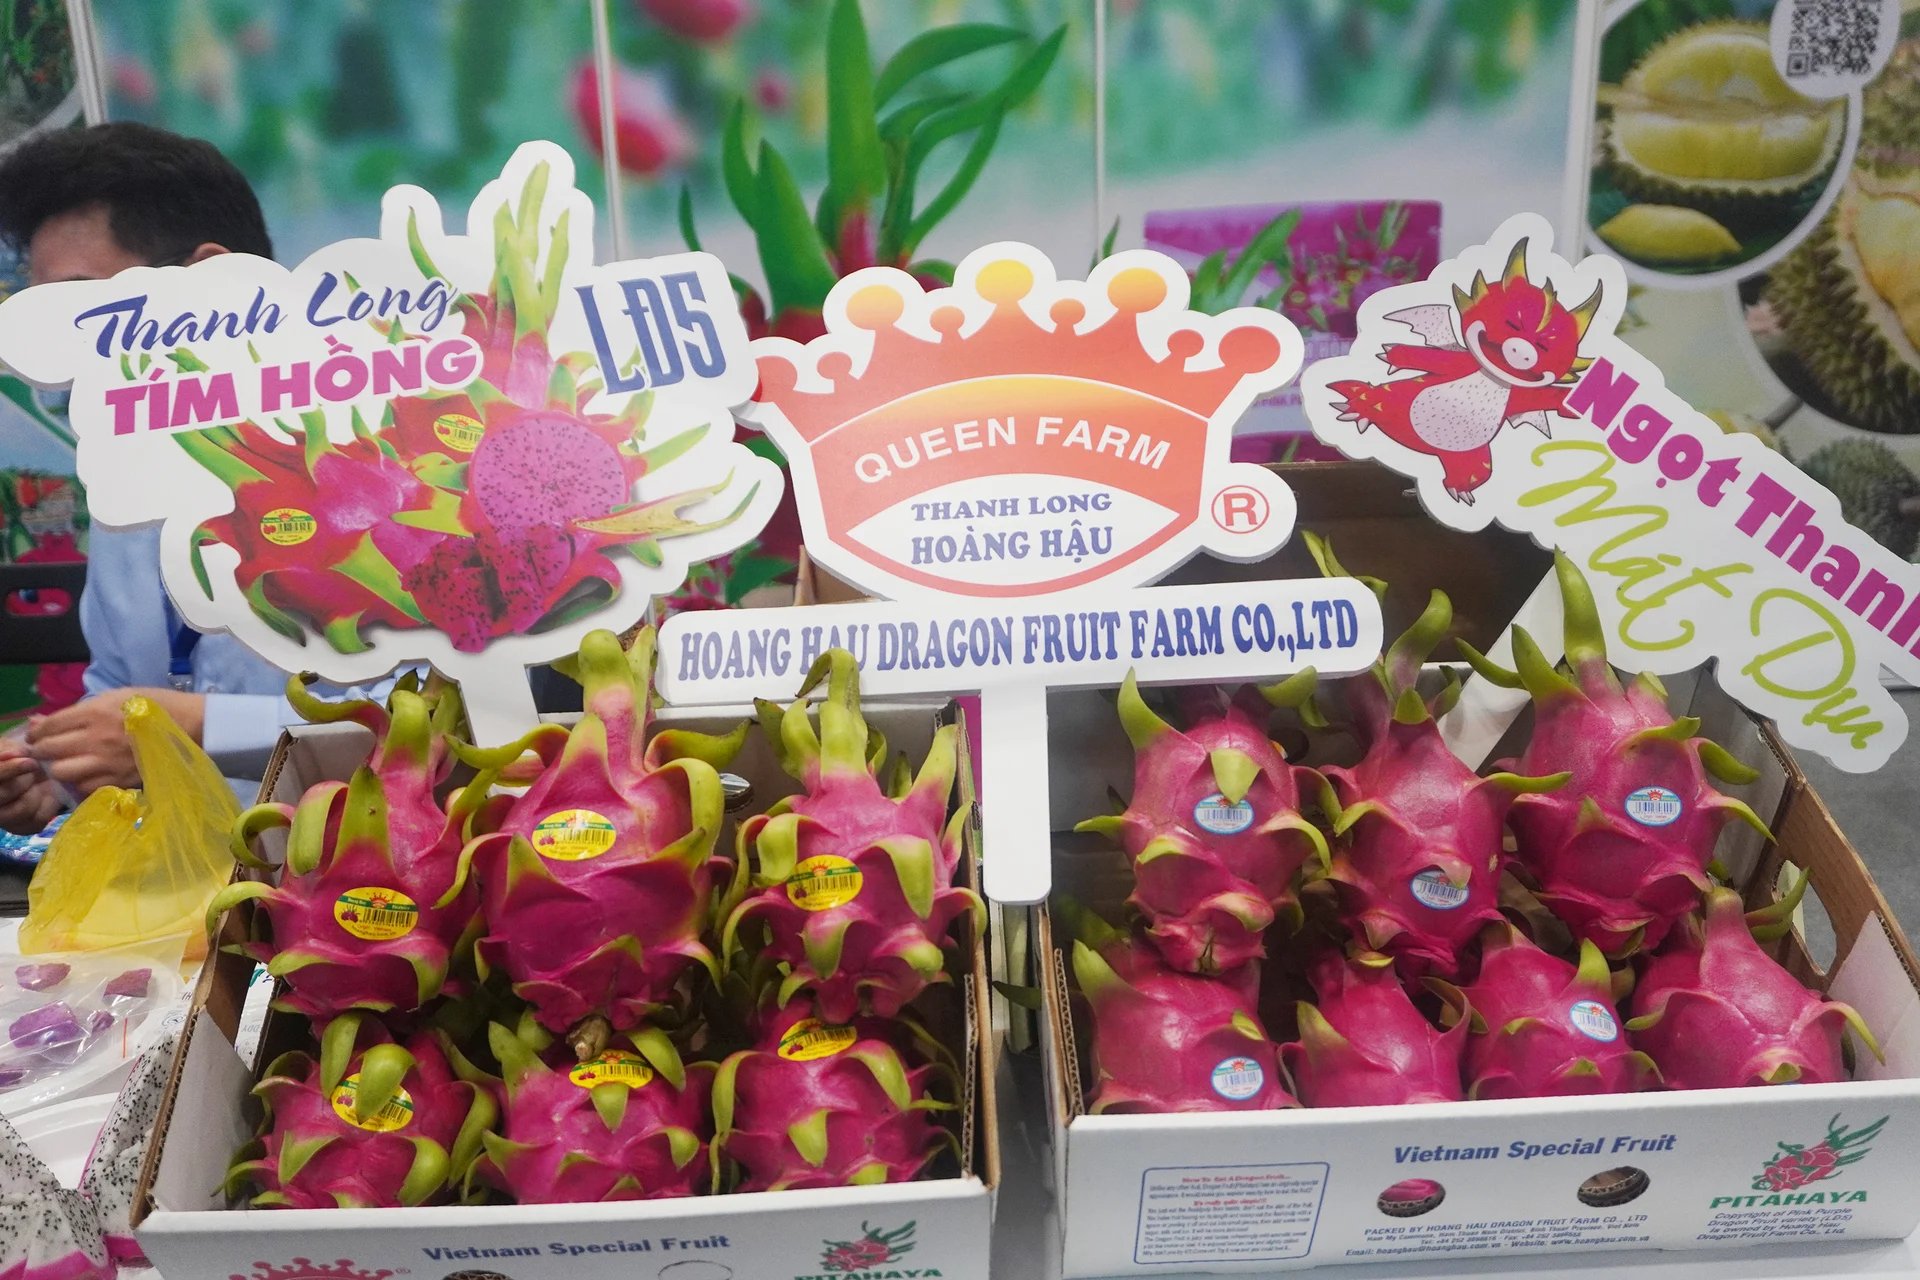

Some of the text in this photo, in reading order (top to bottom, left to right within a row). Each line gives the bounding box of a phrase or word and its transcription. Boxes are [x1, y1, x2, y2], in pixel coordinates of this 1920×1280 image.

[74, 271, 458, 358] Thanh Long
[573, 271, 727, 395] LĐ5
[105, 334, 477, 436] TÍM HỒNG
[1565, 355, 1742, 508] Ngọt
[854, 415, 1171, 483] QUEEN FARM
[911, 493, 1113, 521] THANH LONG
[911, 519, 1113, 565] HOÀNG HẬU
[678, 628, 791, 681] HOANG
[876, 616, 1014, 672] DRAGON
[1022, 611, 1121, 664] FRUIT
[1129, 605, 1225, 659] FARM
[1395, 1134, 1677, 1163] Vietnam Special Fruit
[1709, 1190, 1867, 1208] PITAHAYA
[1364, 1227, 1405, 1236] PACKED
[1426, 1223, 1462, 1232] HOANG
[1490, 1220, 1534, 1228] DRAGON
[1537, 1218, 1567, 1226] FRUIT
[1707, 1219, 1748, 1227] Dragon
[1781, 1216, 1819, 1224] variety
[1715, 1211, 1770, 1220] Copyright
[1815, 1208, 1852, 1216] Purple
[1723, 1225, 1760, 1233] owned
[1781, 1223, 1816, 1231] Hoang
[422, 1235, 731, 1260] Vietnam Special Fruit
